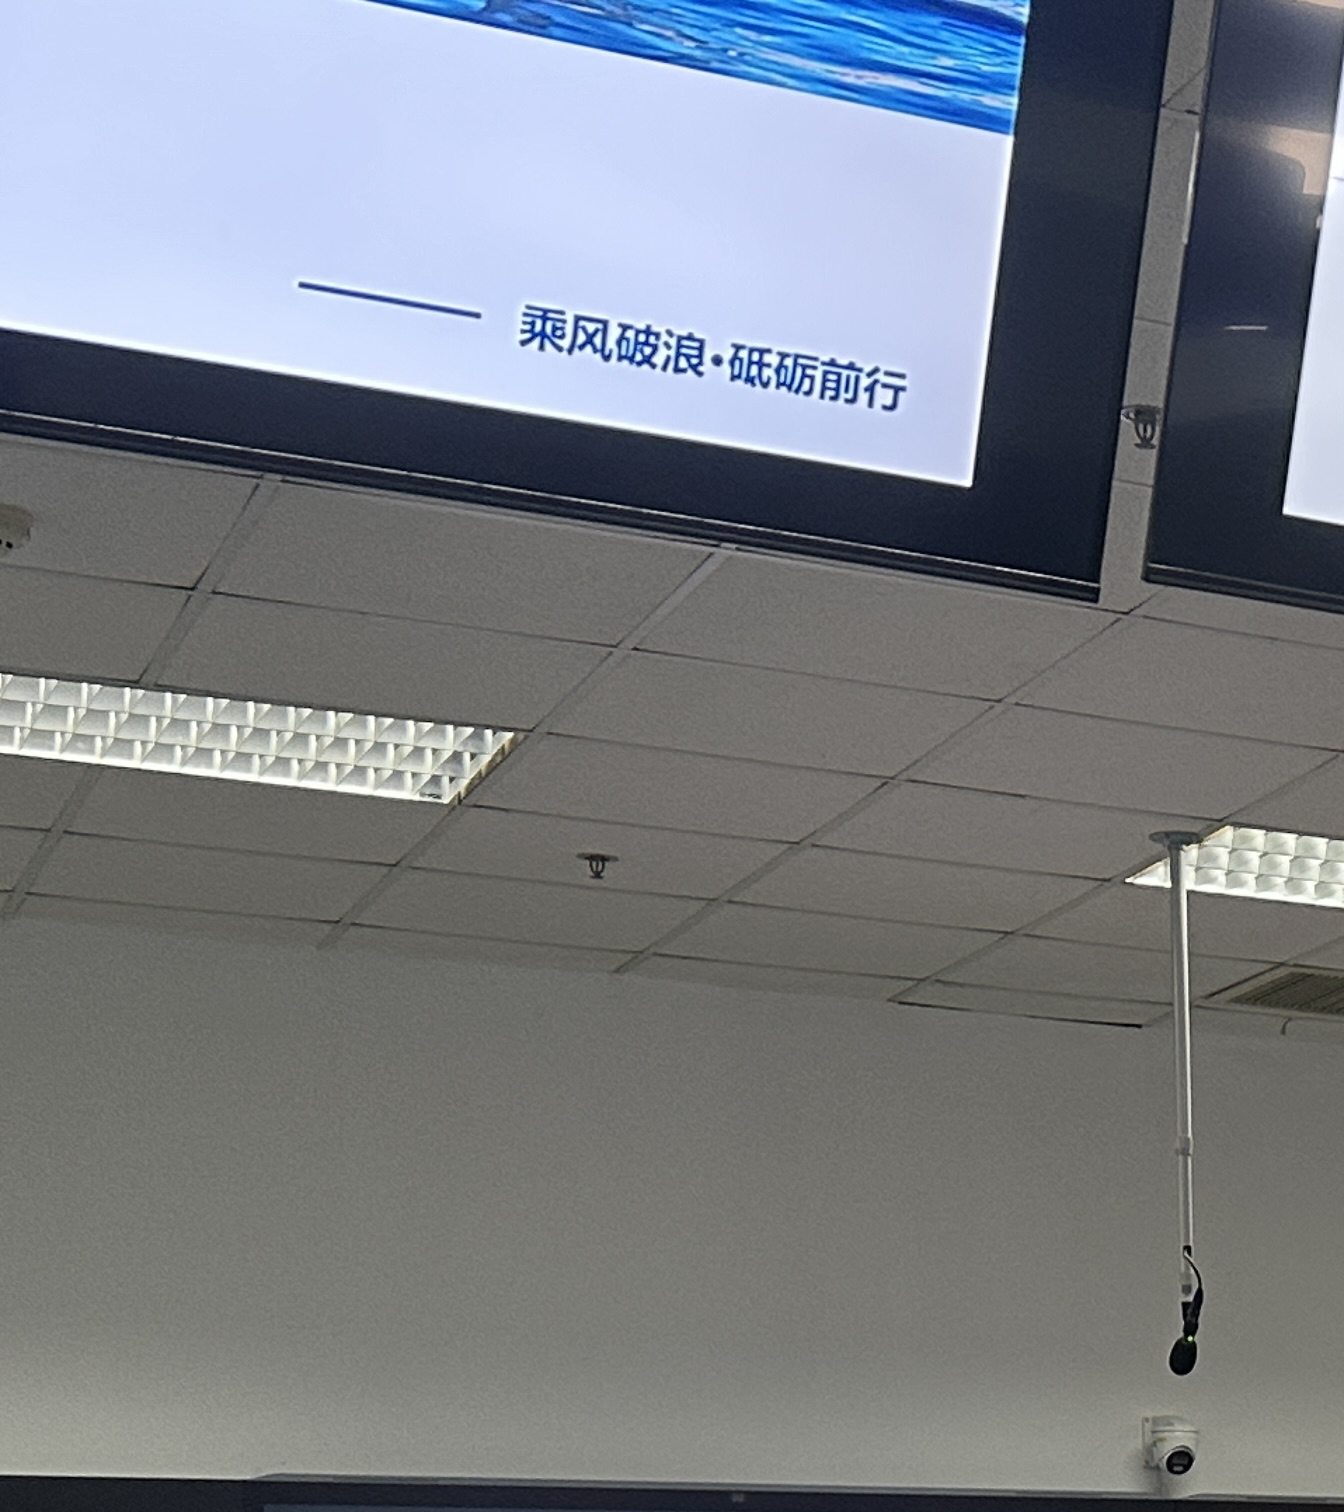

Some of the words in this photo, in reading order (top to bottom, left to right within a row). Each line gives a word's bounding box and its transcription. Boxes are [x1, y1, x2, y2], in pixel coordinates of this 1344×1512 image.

[518, 303, 908, 413] 乘风破浪·砥砺前行
